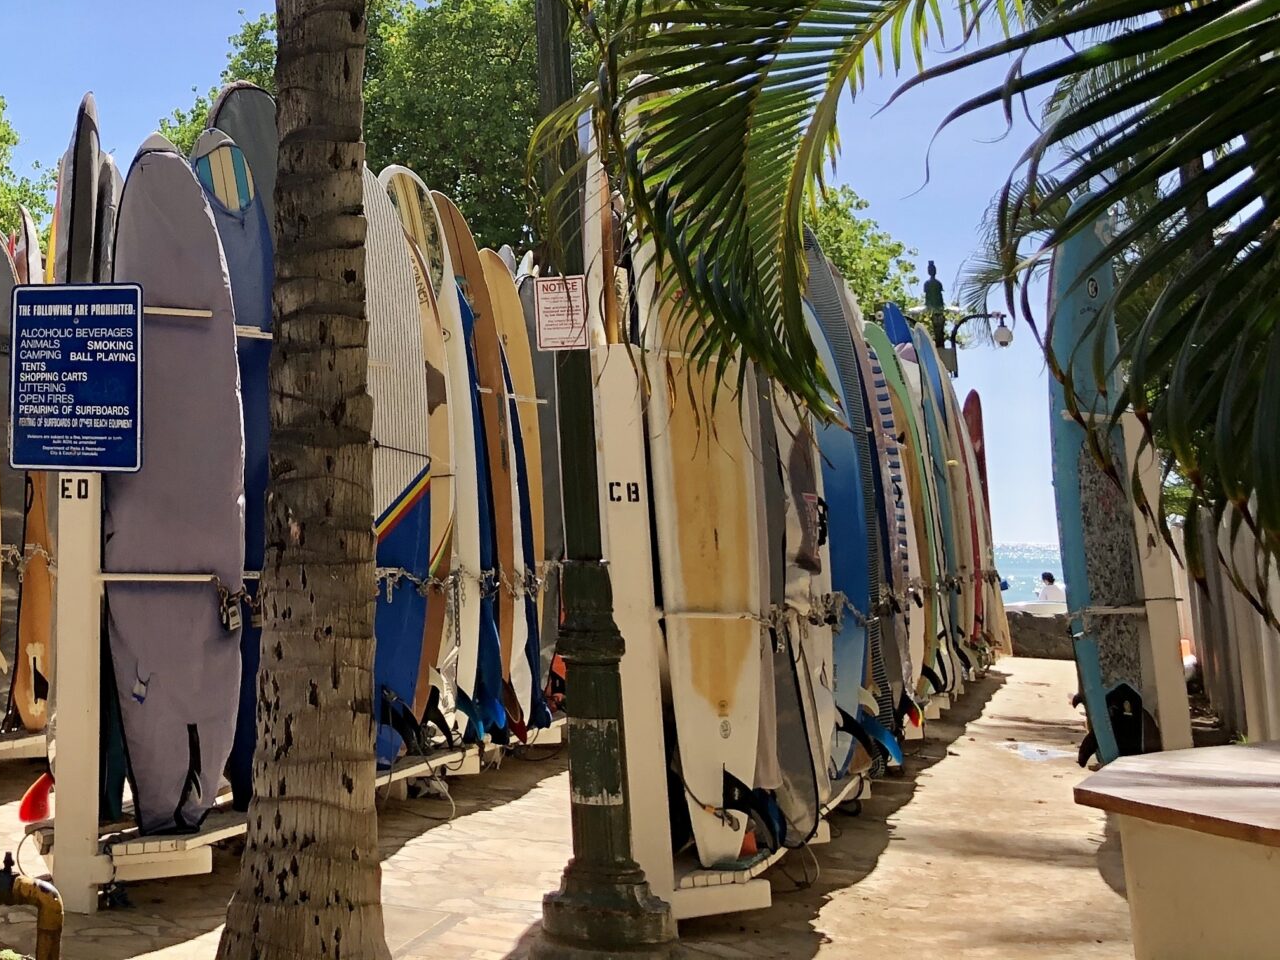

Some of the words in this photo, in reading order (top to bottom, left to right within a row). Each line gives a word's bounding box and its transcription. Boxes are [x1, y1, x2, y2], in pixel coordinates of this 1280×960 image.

[19, 305, 31, 316] THE
[33, 304, 72, 316] FOLLOWING
[75, 304, 88, 315] ARE
[20, 328, 73, 338] ALCOHOLIC
[76, 328, 133, 337] BEVERAGES
[20, 340, 60, 348] ANIMALS
[87, 341, 133, 350] SMOKING
[20, 350, 61, 359] CAMPING
[70, 352, 93, 361] BALL
[96, 353, 135, 362] PLAYING
[21, 362, 46, 371] TENTS
[20, 372, 58, 381] SHOPPING
[61, 372, 87, 381] CARTS
[19, 383, 66, 392] LITTERING
[19, 394, 45, 403] OPEN
[47, 394, 74, 403] FIRES
[62, 405, 72, 414] OF
[76, 406, 129, 415] SURFBOARDS
[94, 419, 107, 427] BEACH
[609, 482, 640, 502] CB
